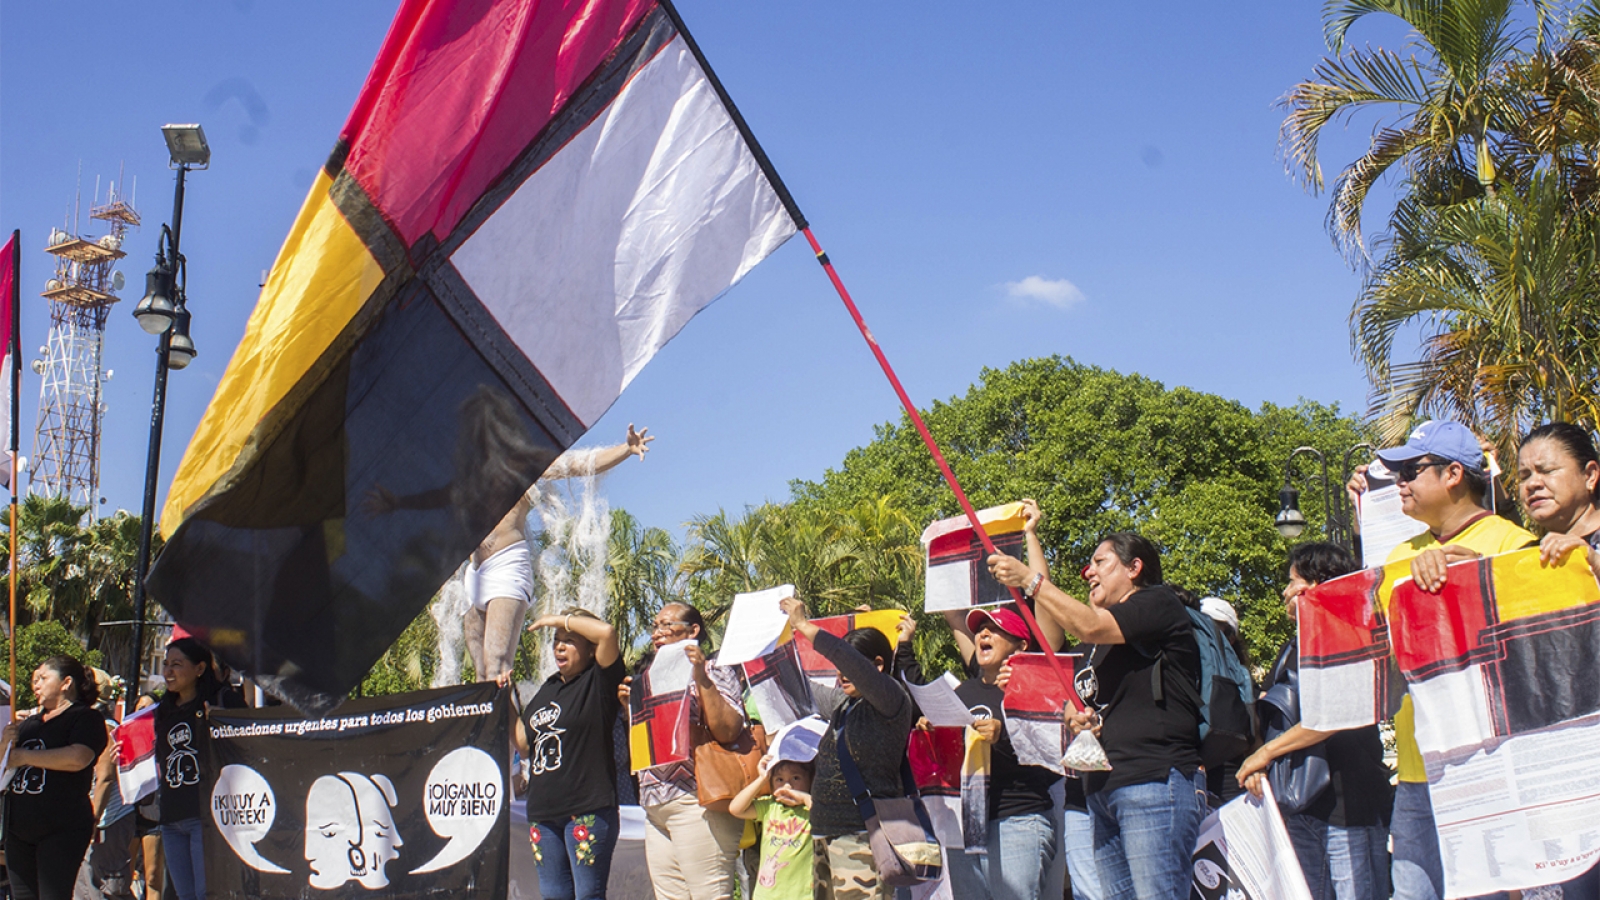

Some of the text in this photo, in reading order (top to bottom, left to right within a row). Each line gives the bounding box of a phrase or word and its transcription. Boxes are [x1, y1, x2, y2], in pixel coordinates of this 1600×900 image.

[284, 718, 338, 736] urgentes
[339, 715, 368, 731] para
[370, 711, 405, 726] todos
[405, 709, 426, 722] los
[427, 702, 493, 724] gobiernos
[429, 778, 496, 799] ¡OÍGANLO
[259, 792, 271, 807] A
[429, 799, 495, 816] MUY BIEN!
